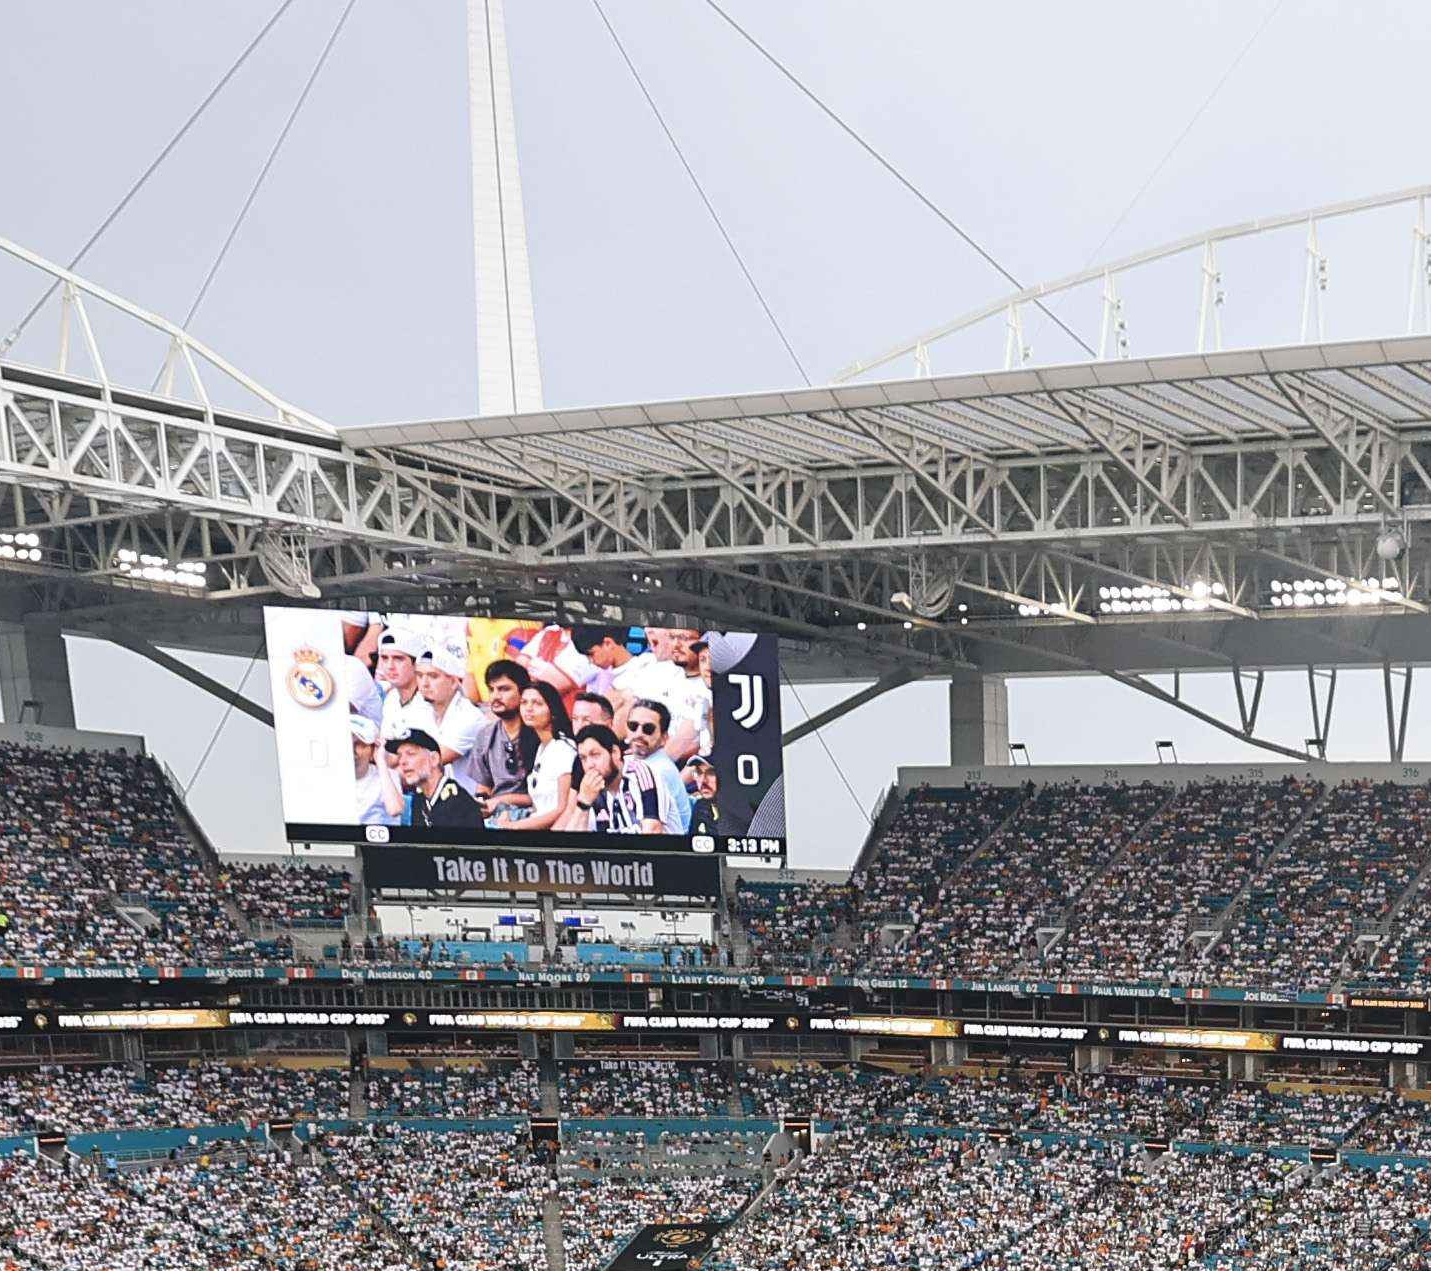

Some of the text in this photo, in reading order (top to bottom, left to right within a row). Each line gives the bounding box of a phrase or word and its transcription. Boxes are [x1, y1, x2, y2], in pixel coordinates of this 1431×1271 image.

[737, 754, 759, 785] 0
[727, 837, 780, 853] 3:13 PM
[433, 856, 654, 887] Take It To The World
